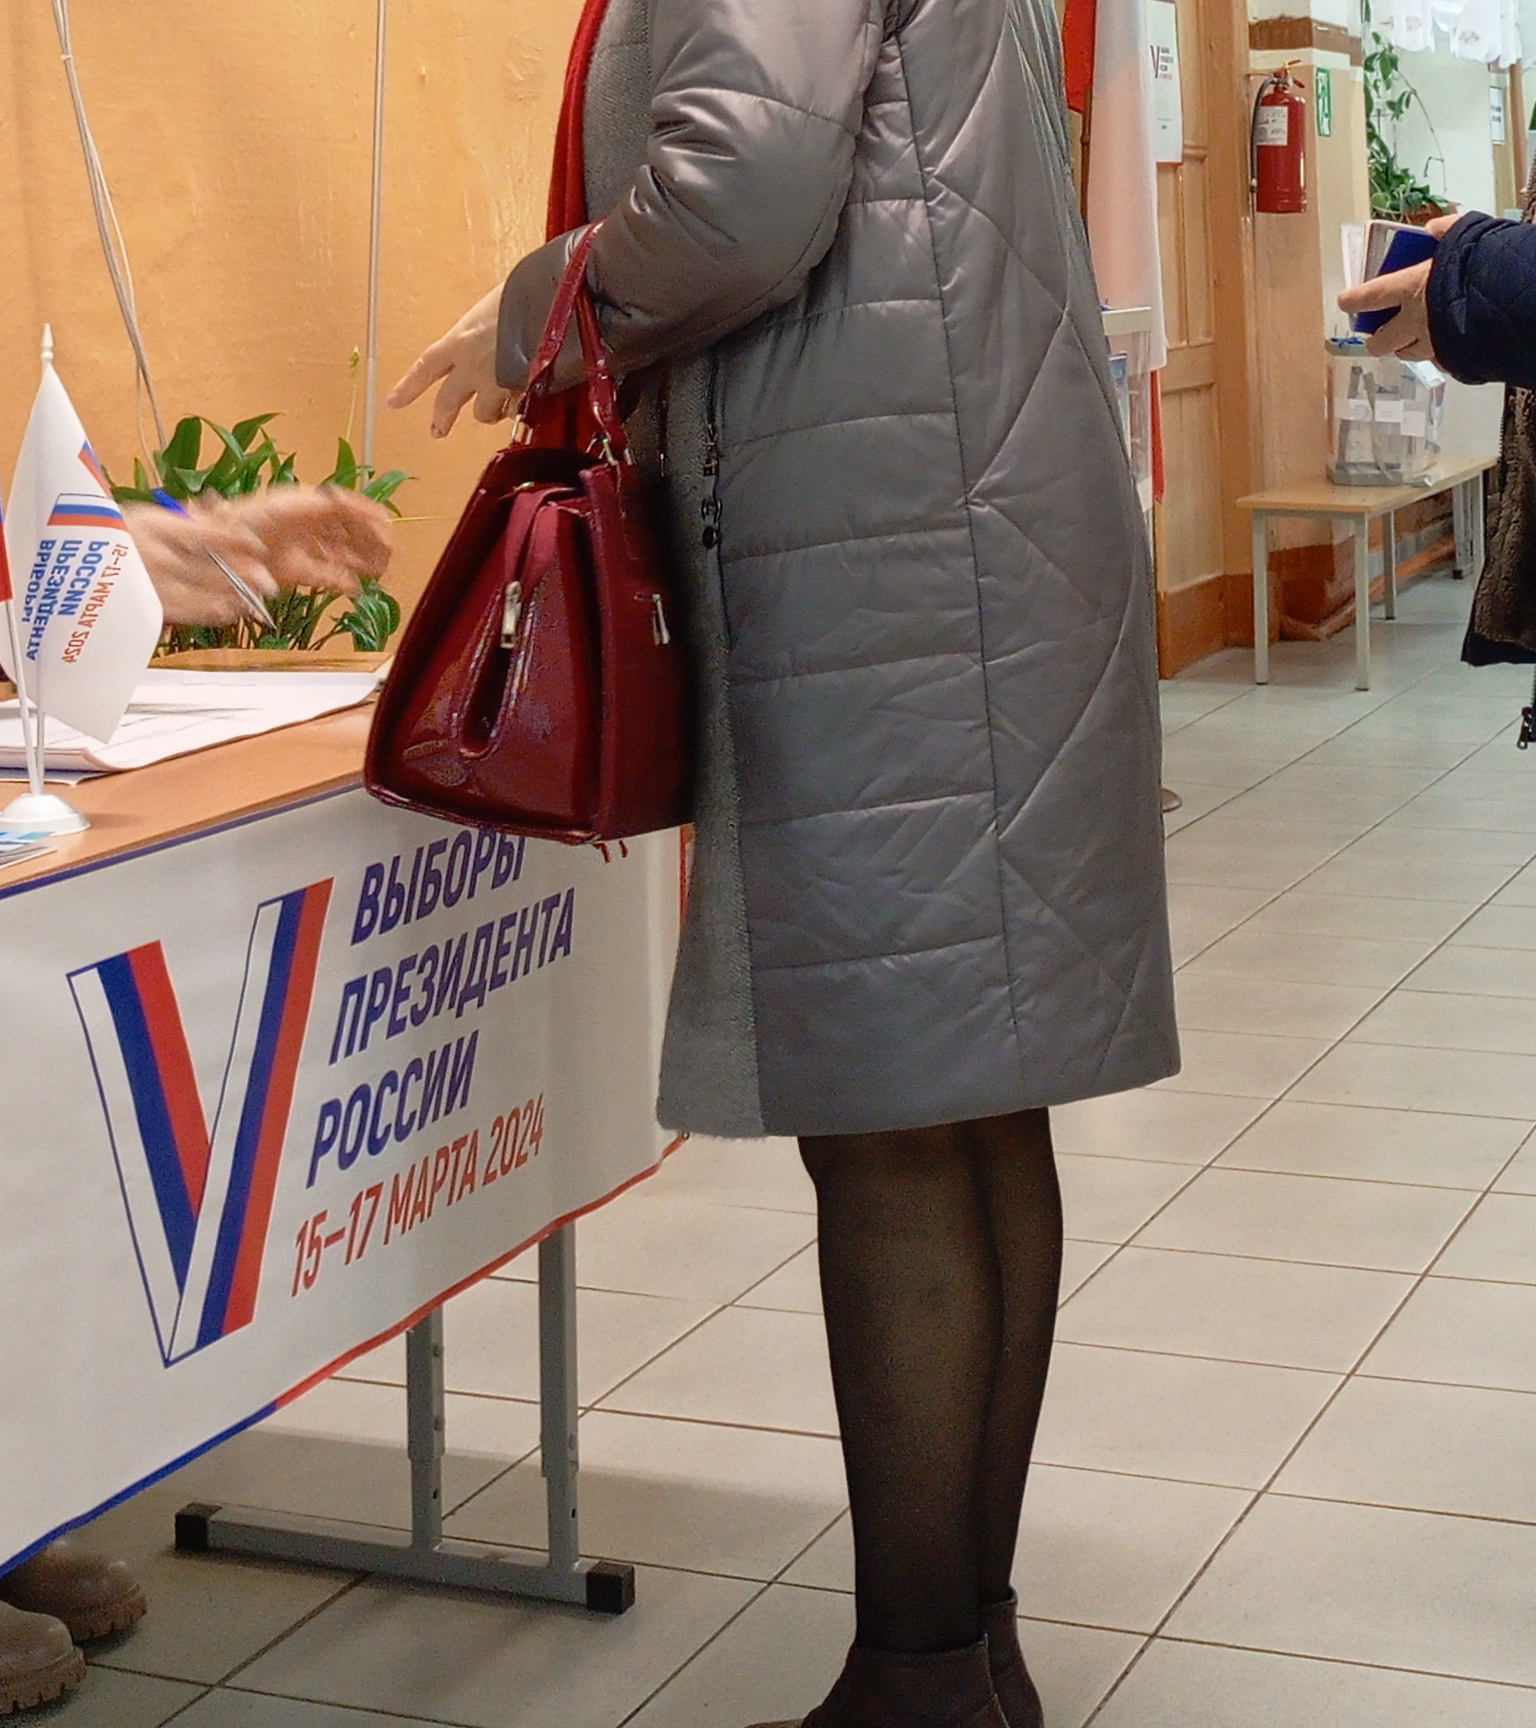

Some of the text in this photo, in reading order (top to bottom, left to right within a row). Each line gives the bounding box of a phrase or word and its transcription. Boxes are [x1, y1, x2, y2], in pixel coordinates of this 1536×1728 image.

[350, 828, 528, 947] ВЫБОРЫ
[328, 887, 575, 1066] ПРЕЗИДЕНТА
[306, 1029, 479, 1189] РОССИИ
[383, 1128, 479, 1246] МАРТА
[481, 1092, 545, 1188] 2024
